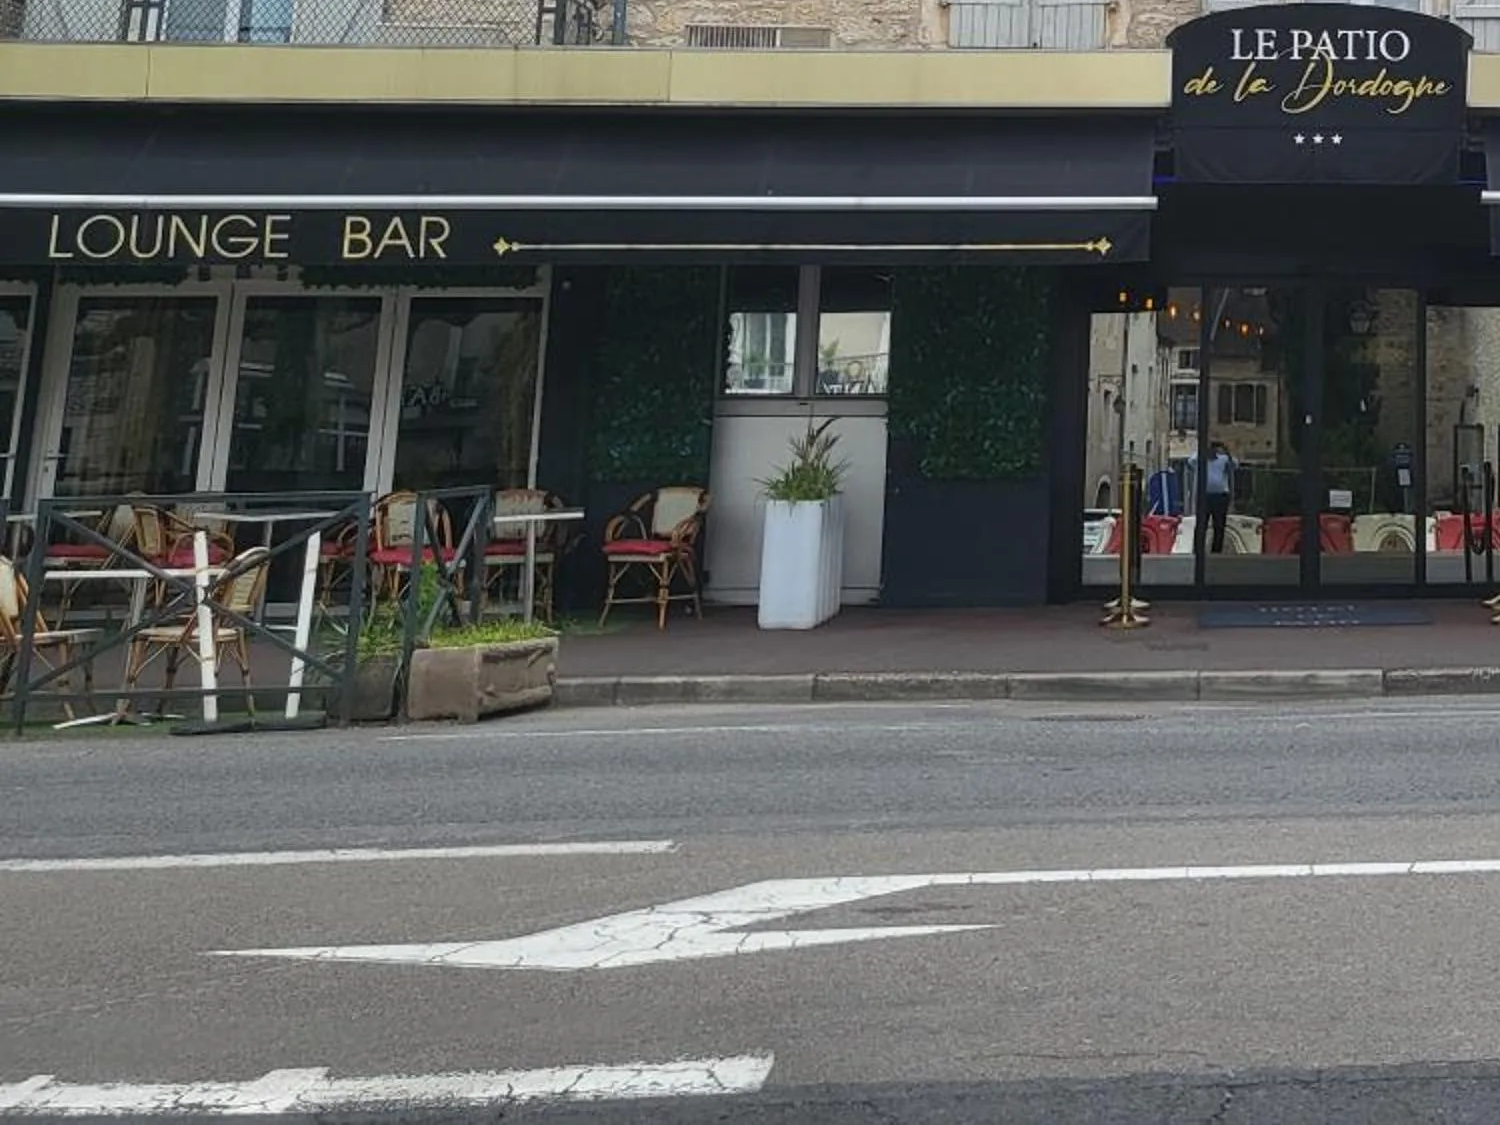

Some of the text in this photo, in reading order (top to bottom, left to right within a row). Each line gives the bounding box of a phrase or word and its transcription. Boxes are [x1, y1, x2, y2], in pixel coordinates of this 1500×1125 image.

[1230, 29, 1411, 62] LE PATIO
[1184, 45, 1454, 114] de la Dordogne
[48, 213, 451, 260] LOUNGE BAR
